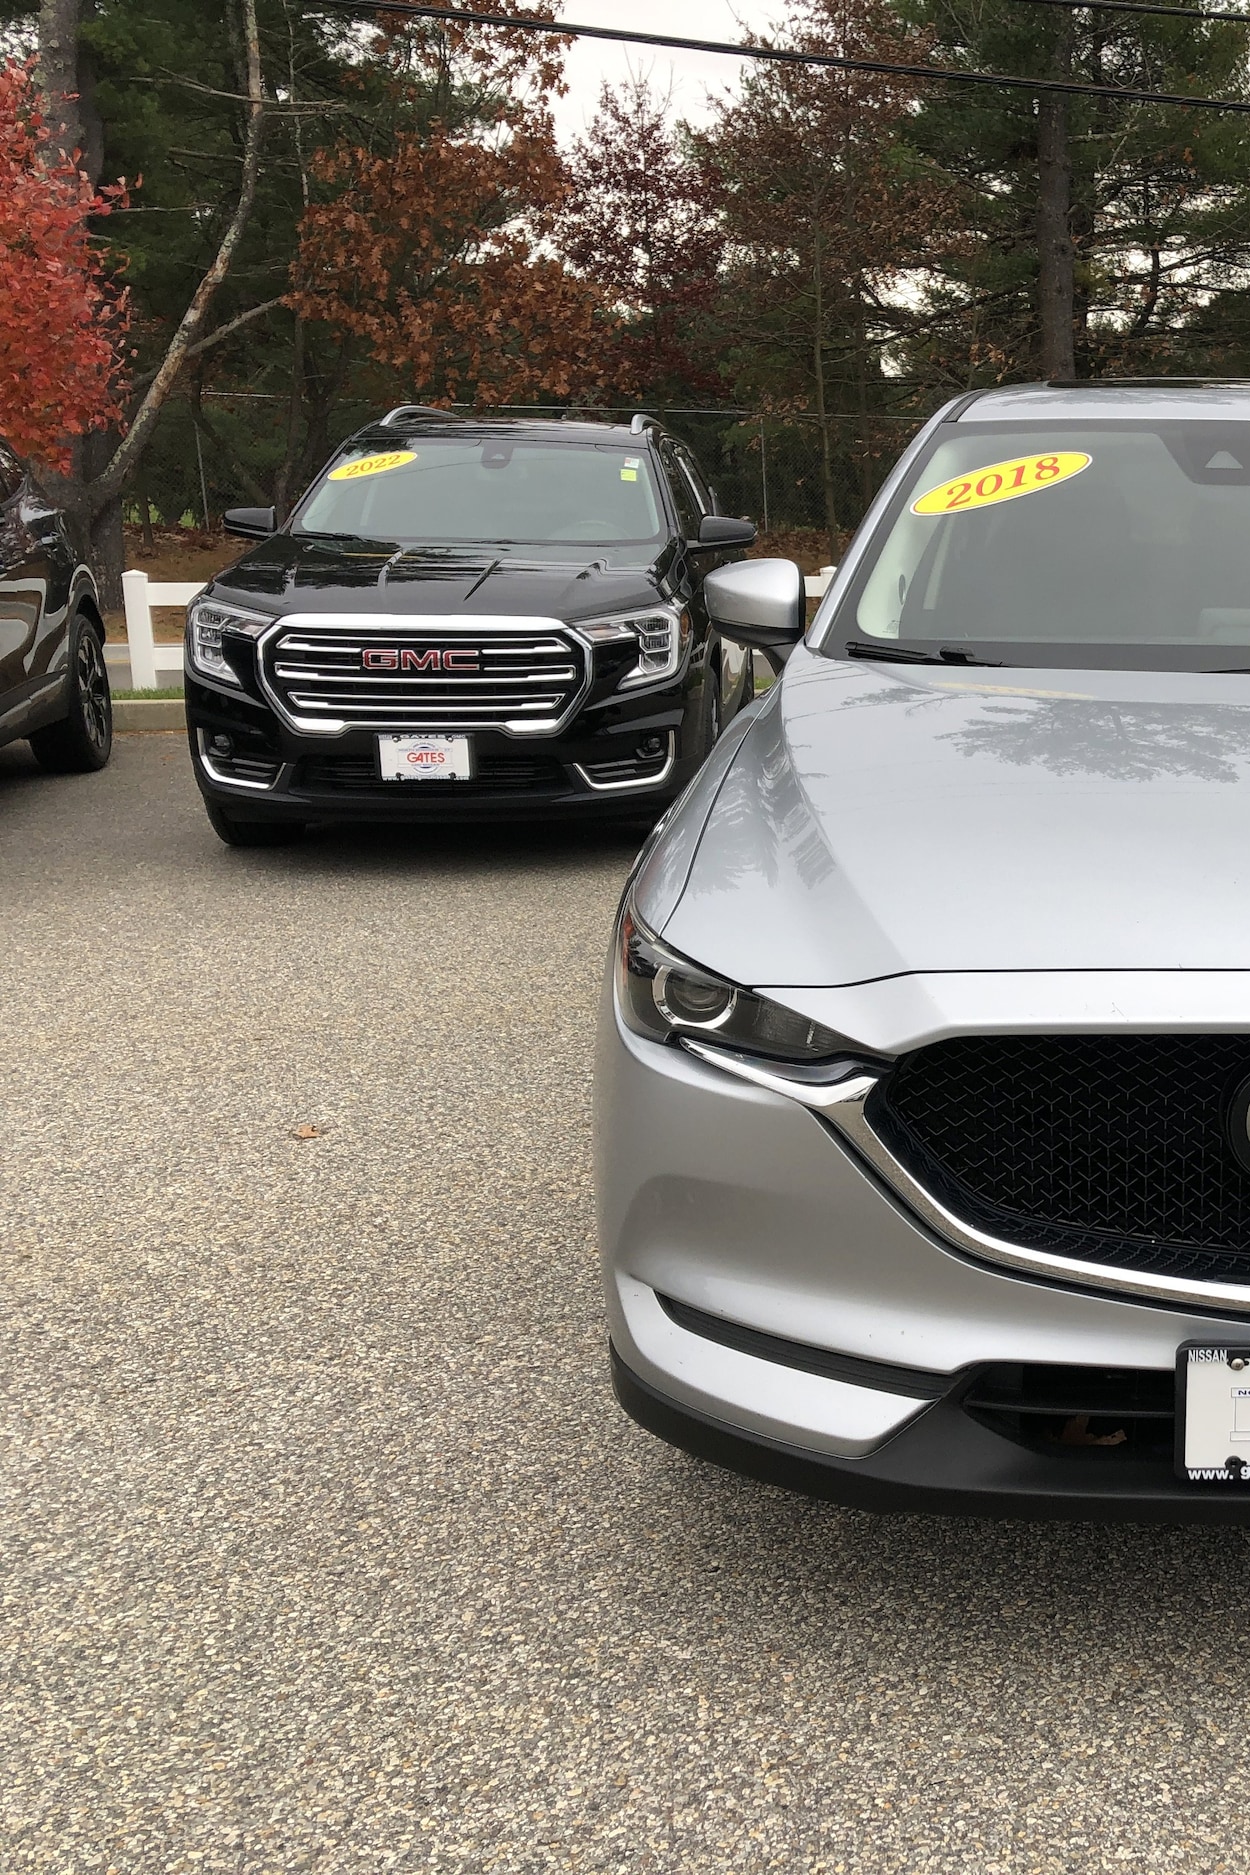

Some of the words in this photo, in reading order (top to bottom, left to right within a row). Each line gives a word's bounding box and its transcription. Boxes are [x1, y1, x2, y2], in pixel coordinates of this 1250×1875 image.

[346, 454, 401, 477] 2022
[945, 456, 1060, 509] 2018
[362, 649, 480, 671] GMC
[406, 752, 445, 763] GATES
[1188, 1349, 1228, 1362] NISSAN
